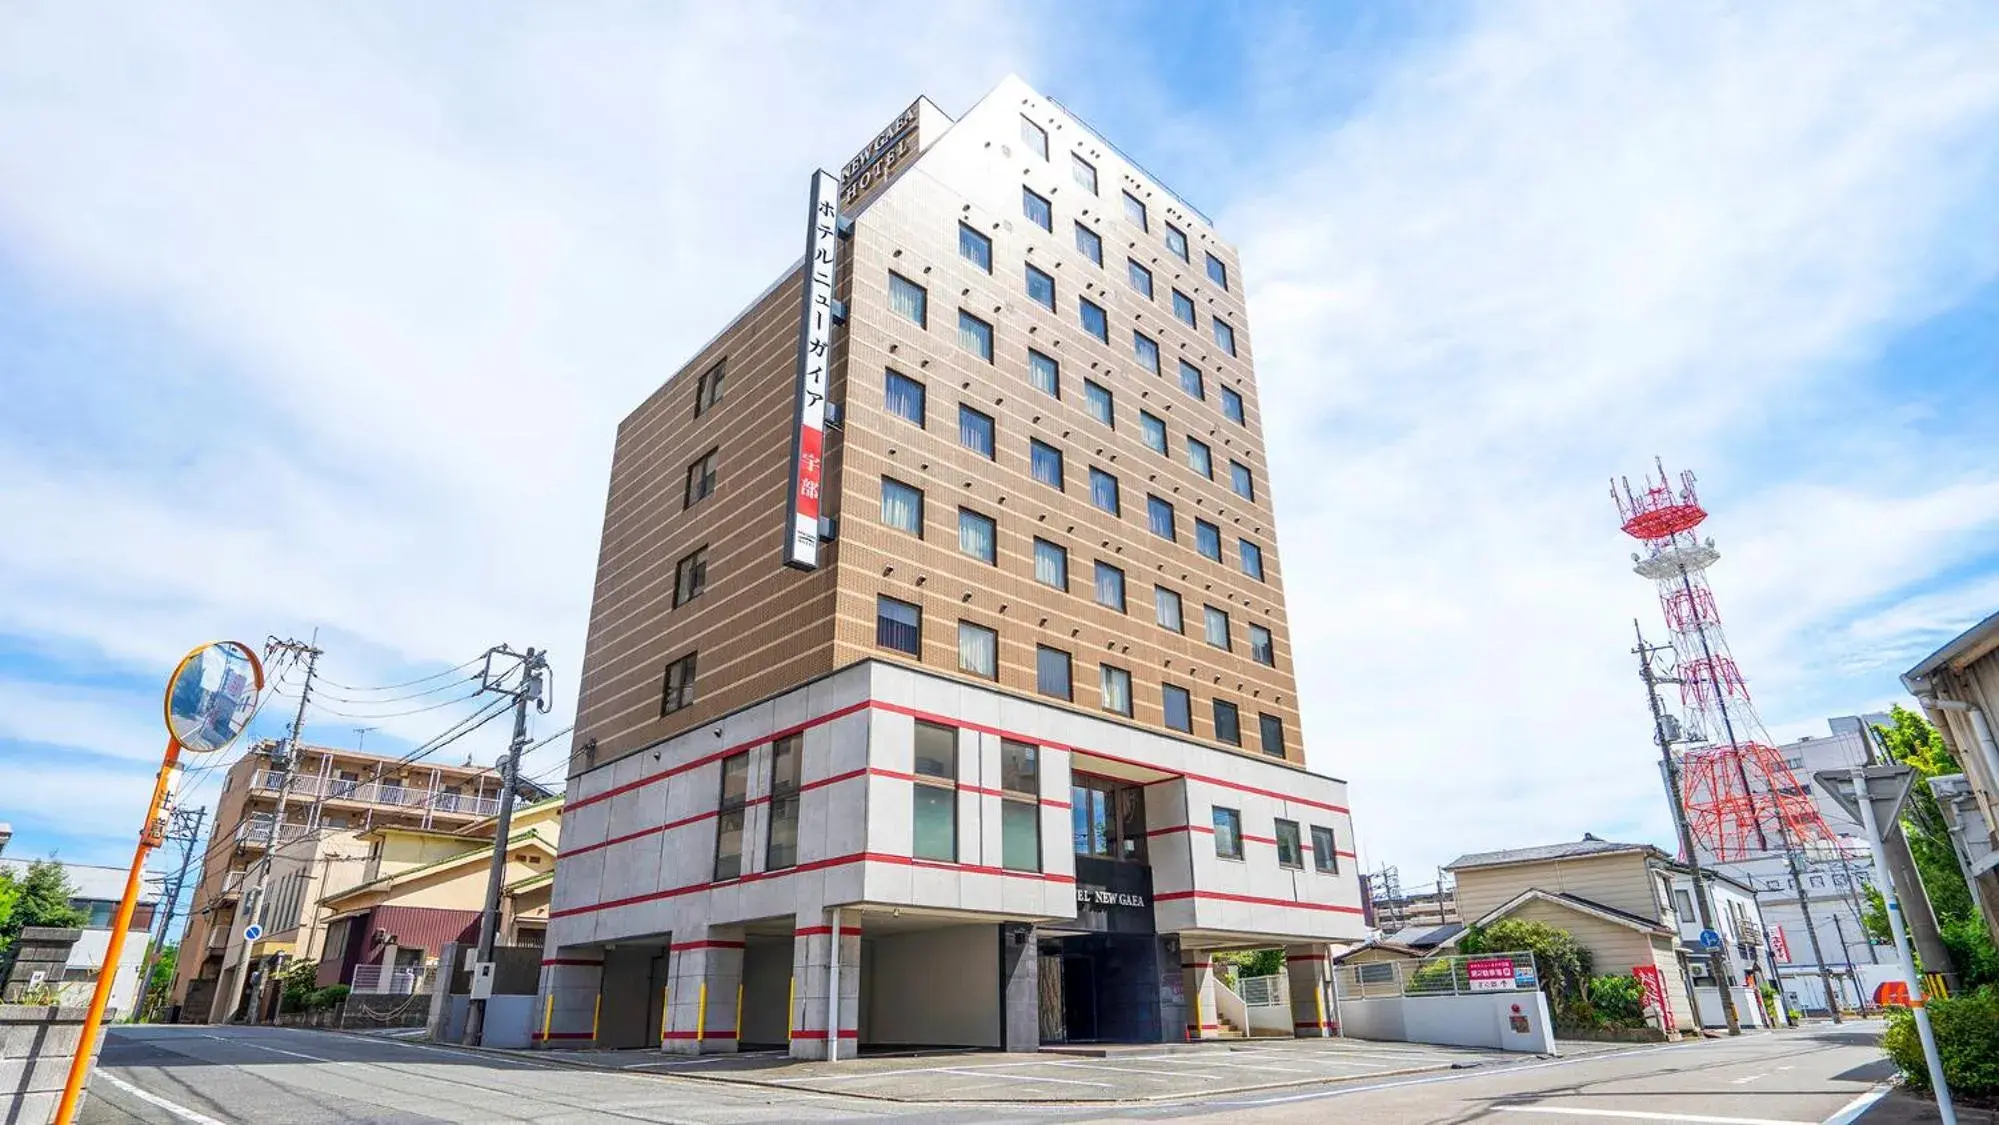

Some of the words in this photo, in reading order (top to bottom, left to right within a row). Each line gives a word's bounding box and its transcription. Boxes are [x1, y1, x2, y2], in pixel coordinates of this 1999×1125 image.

[842, 143, 874, 184] NEW
[874, 109, 915, 151] GAEA
[846, 139, 908, 203] HOTEL
[806, 200, 835, 408] ホテルニューガイア
[800, 453, 821, 499] 宇部
[1095, 890, 1118, 905] NEW
[1118, 893, 1145, 907] GAEA
